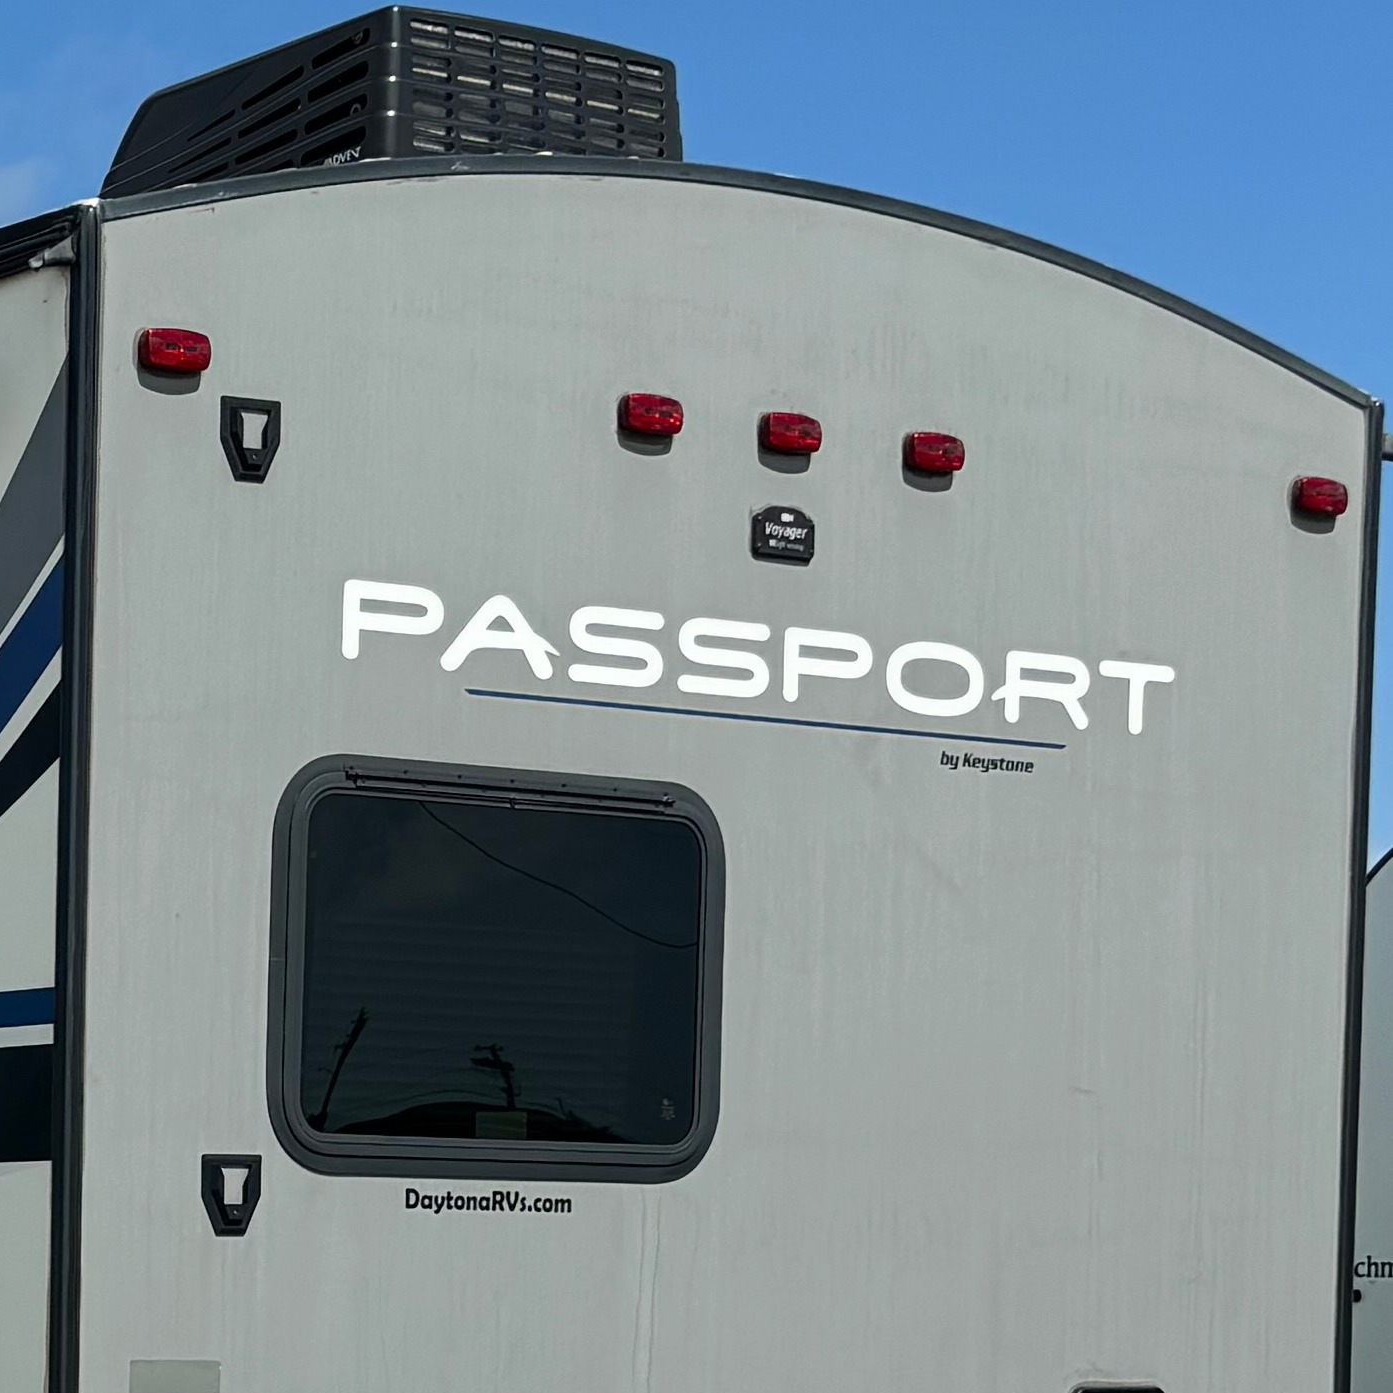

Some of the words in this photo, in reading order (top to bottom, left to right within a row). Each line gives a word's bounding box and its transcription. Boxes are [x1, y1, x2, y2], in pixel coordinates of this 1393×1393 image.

[765, 521, 808, 540] Voyager
[339, 579, 1176, 736] PASSPORT
[940, 751, 960, 770] by
[962, 752, 1034, 773] Keystone
[405, 1188, 572, 1214] DaytonaRVs.com
